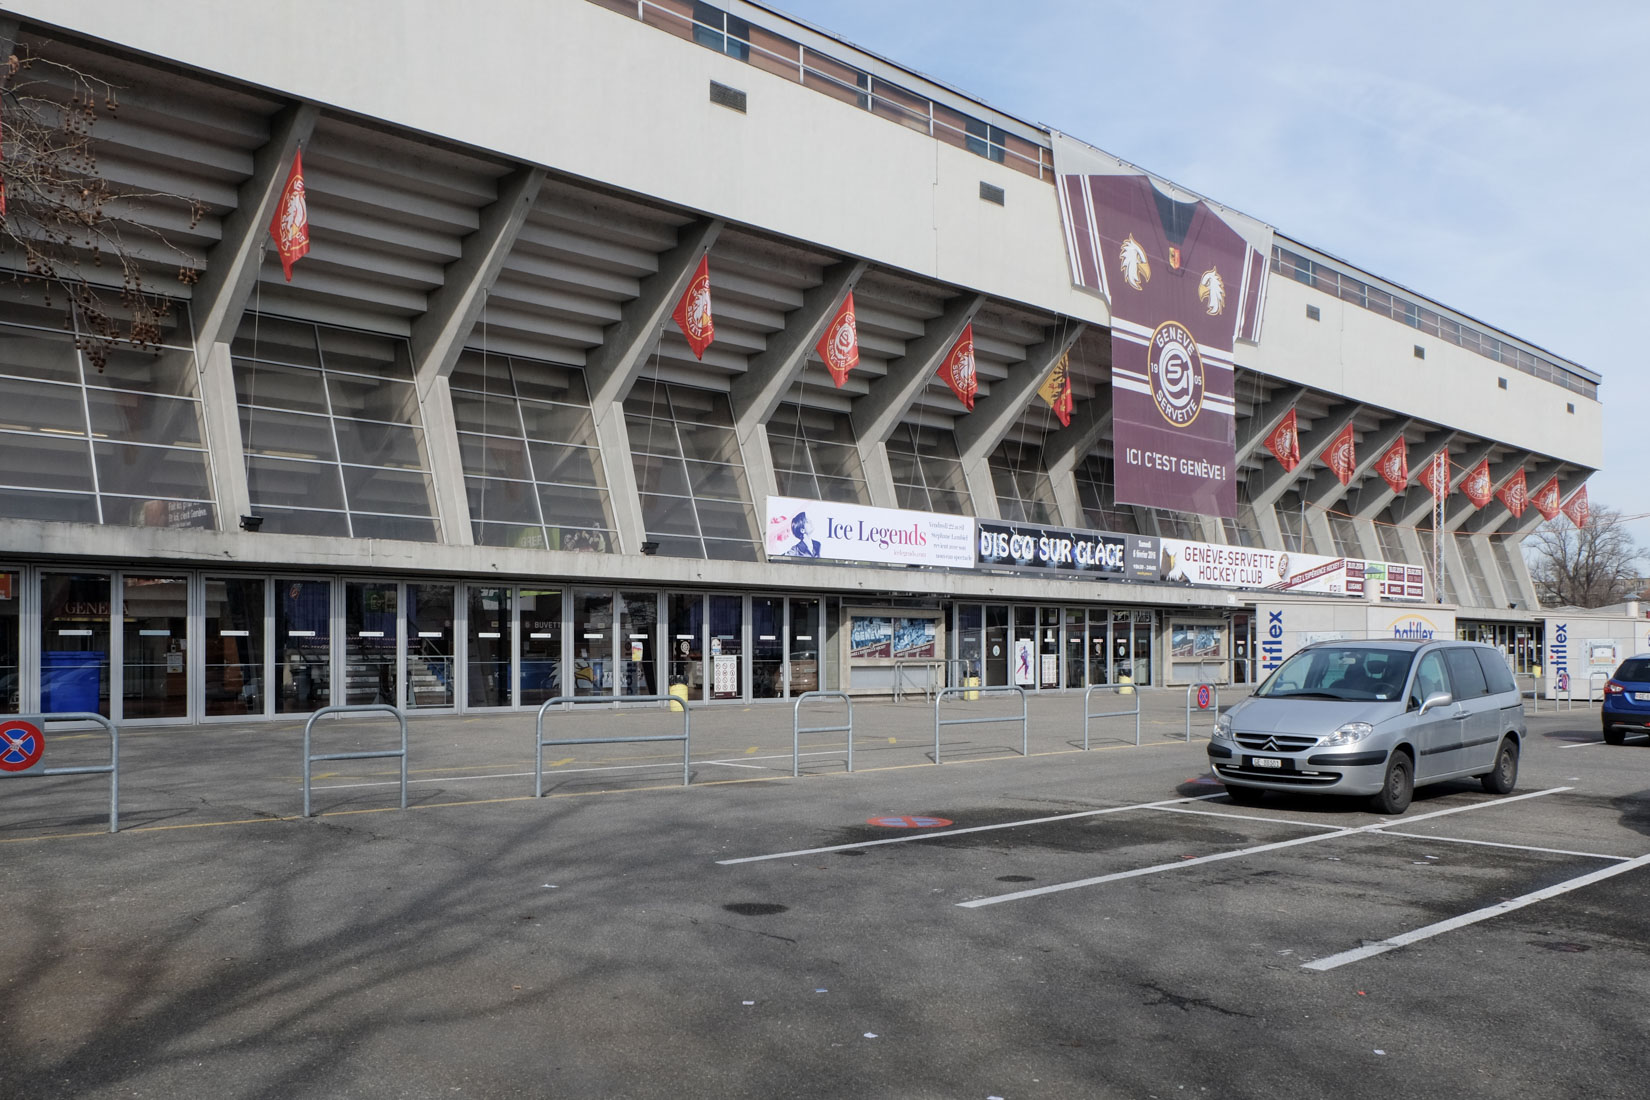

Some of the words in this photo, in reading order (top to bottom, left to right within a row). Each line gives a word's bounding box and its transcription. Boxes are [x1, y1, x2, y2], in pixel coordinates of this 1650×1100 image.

[1156, 326, 1196, 357] GENEVE
[1150, 362, 1159, 374] 19
[1193, 375, 1203, 387] 05
[1156, 389, 1199, 422] SERVETTE
[1126, 447, 1142, 466] ICI
[1144, 451, 1177, 473] C'EST
[826, 517, 853, 541] Ice
[857, 520, 928, 550] Legends
[980, 530, 1035, 560] DISCO
[1039, 536, 1072, 563] SUR
[1076, 539, 1125, 567] GLACE
[1184, 544, 1275, 570] GENÈVE-SERVETTE
[1198, 565, 1237, 583] HOCKEY
[1239, 568, 1263, 585] CLUB
[65, 601, 129, 615] GENEA
[534, 620, 562, 630] BUVETT
